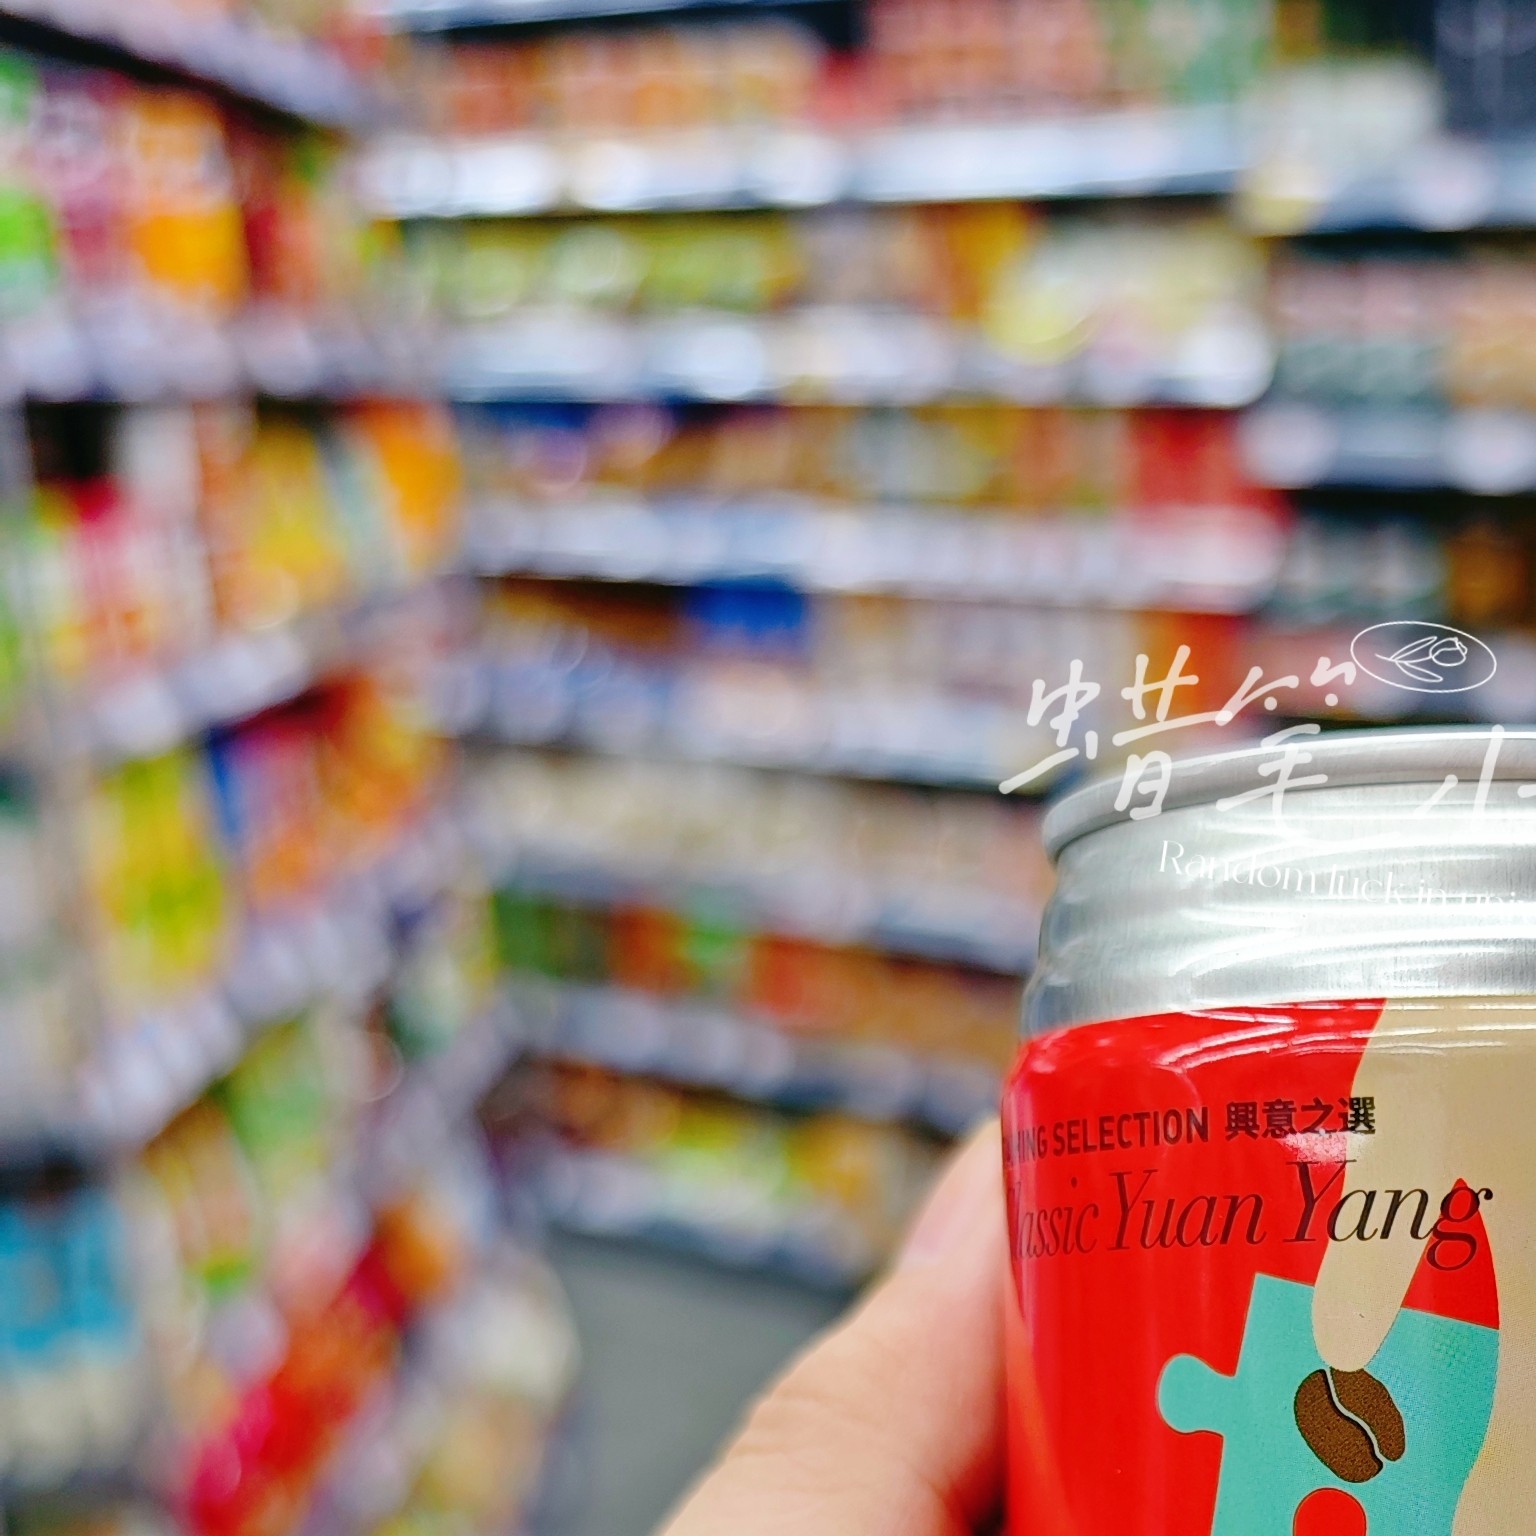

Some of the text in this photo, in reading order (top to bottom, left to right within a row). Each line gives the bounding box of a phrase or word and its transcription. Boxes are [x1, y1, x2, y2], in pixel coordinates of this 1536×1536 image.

[1053, 1106, 1209, 1156] SELECTION
[1224, 1096, 1377, 1142] 興意之選
[1008, 1159, 1494, 1272] lassic Yuan Yang
